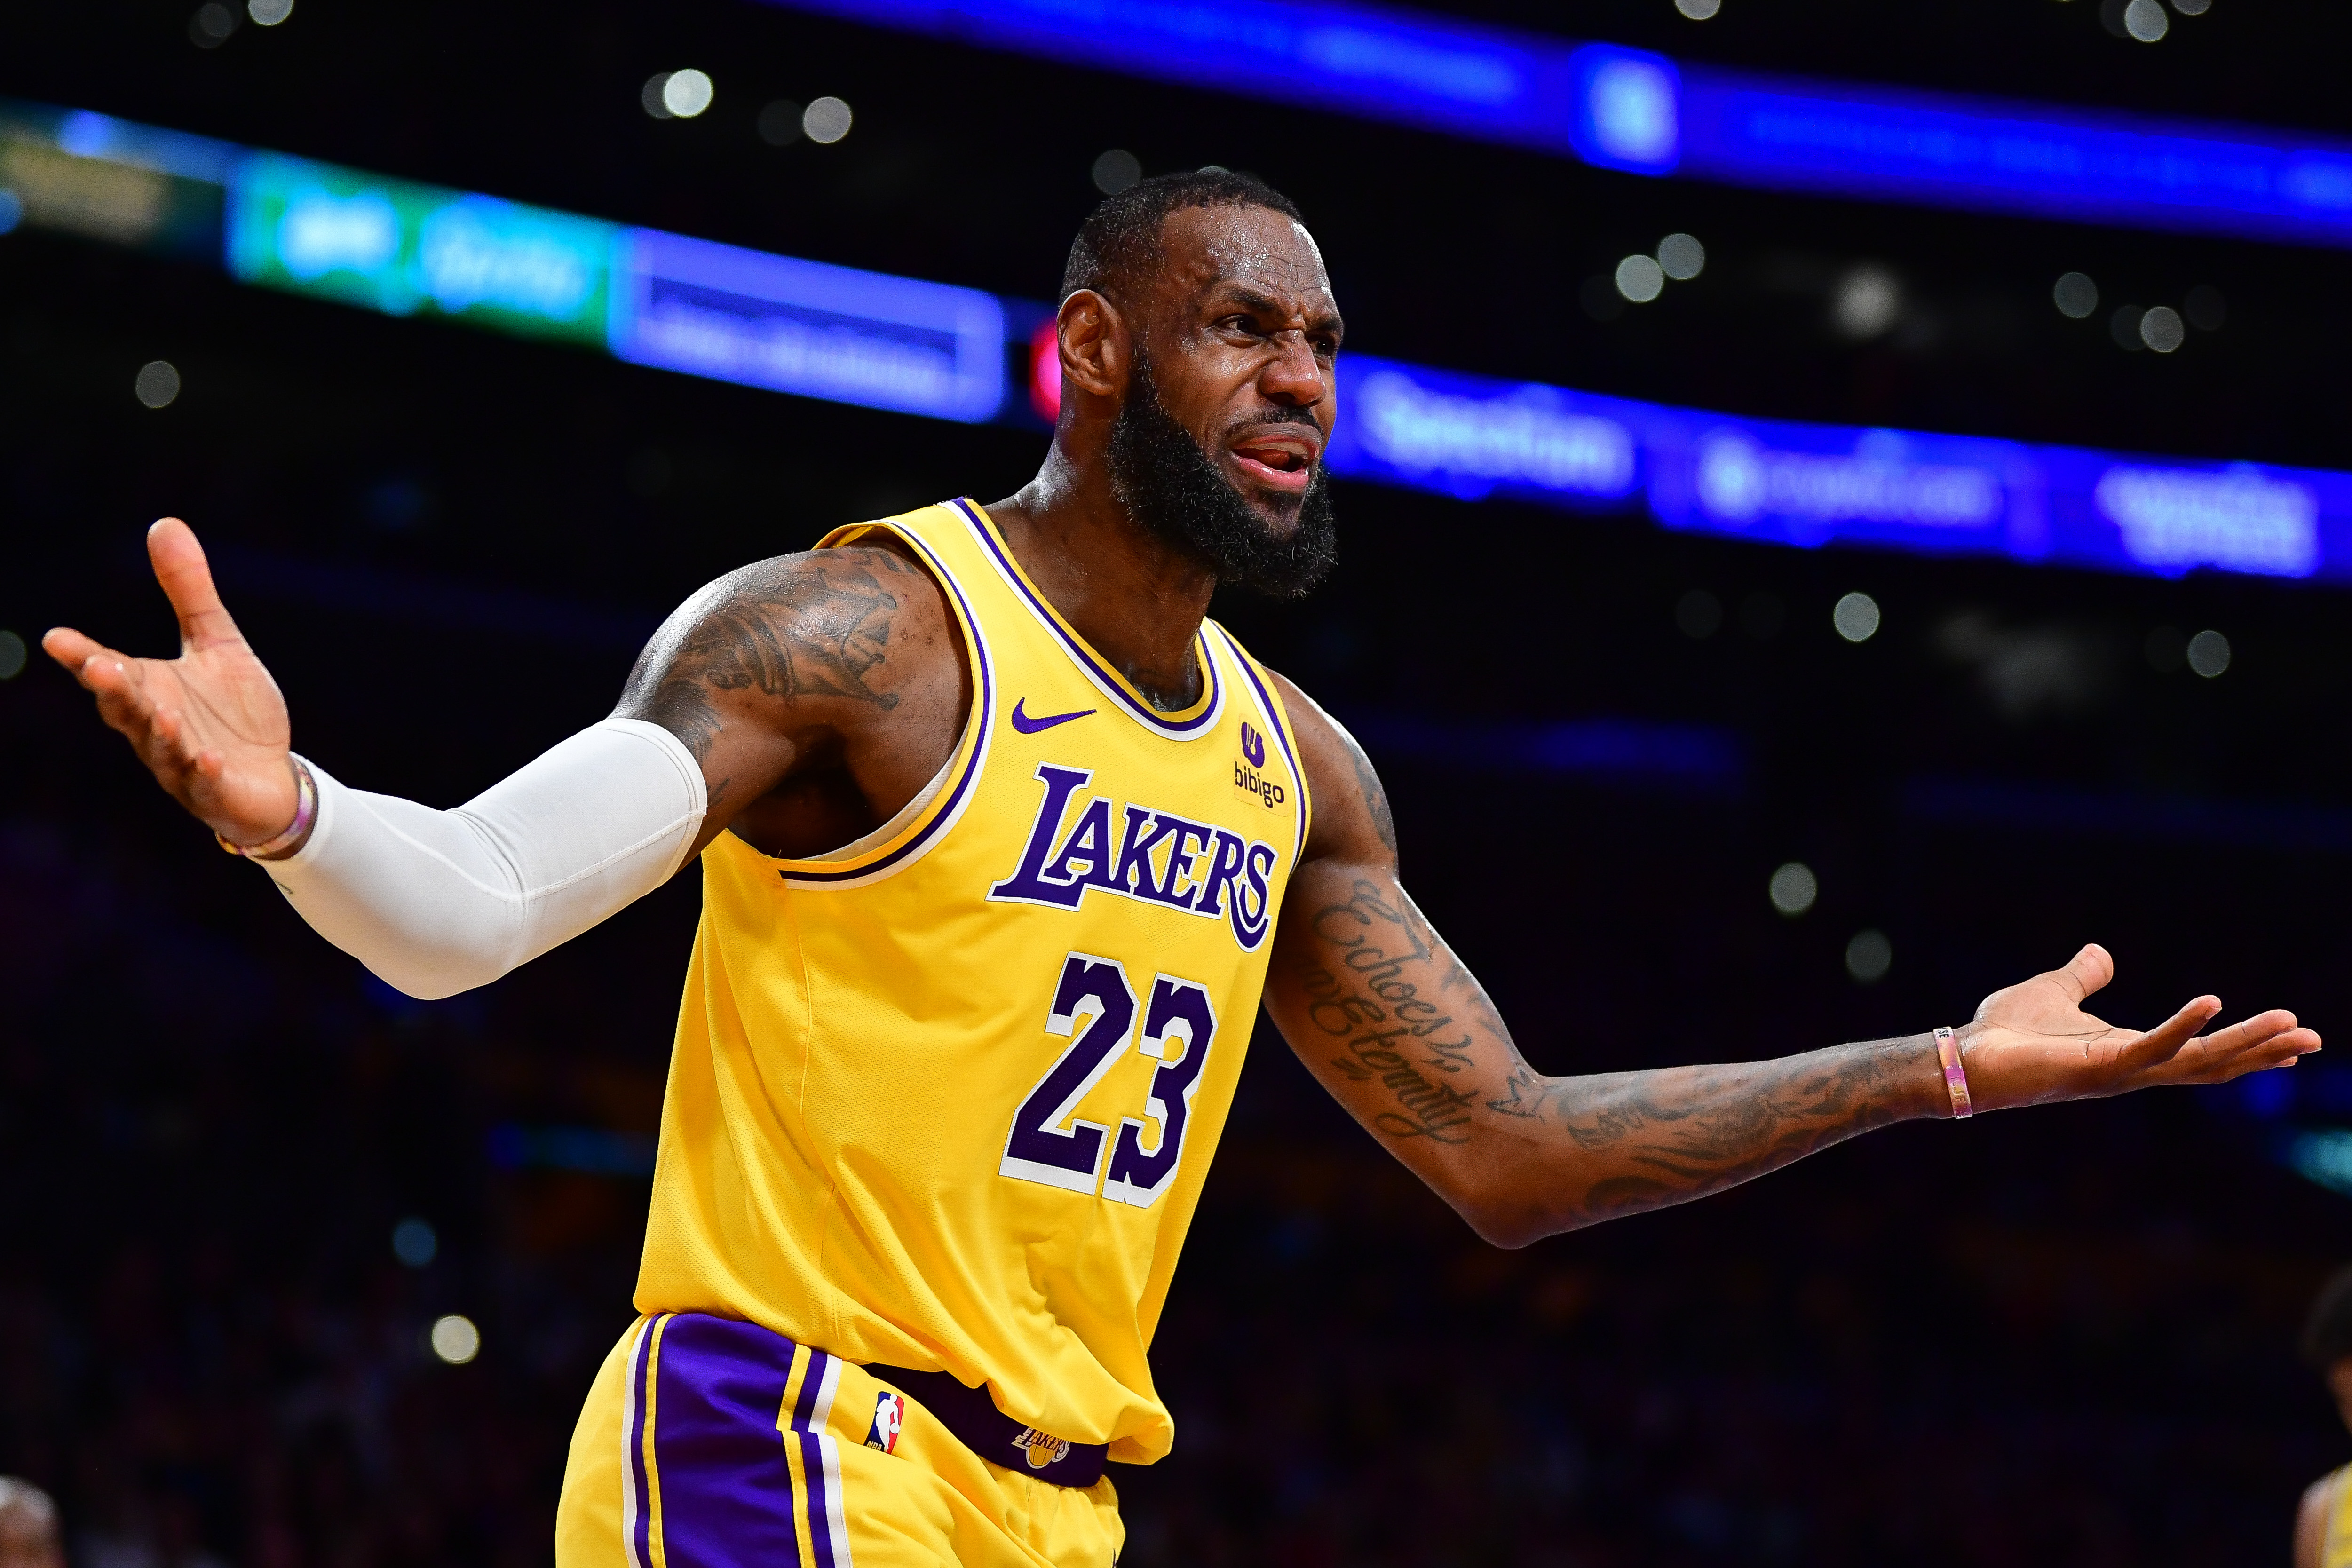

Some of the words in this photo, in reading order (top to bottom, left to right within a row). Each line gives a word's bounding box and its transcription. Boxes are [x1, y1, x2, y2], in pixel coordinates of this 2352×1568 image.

[1235, 760, 1284, 809] bibigo
[985, 760, 1279, 953] LAKERS
[998, 950, 1219, 1209] 23
[866, 1440, 882, 1451] NBA
